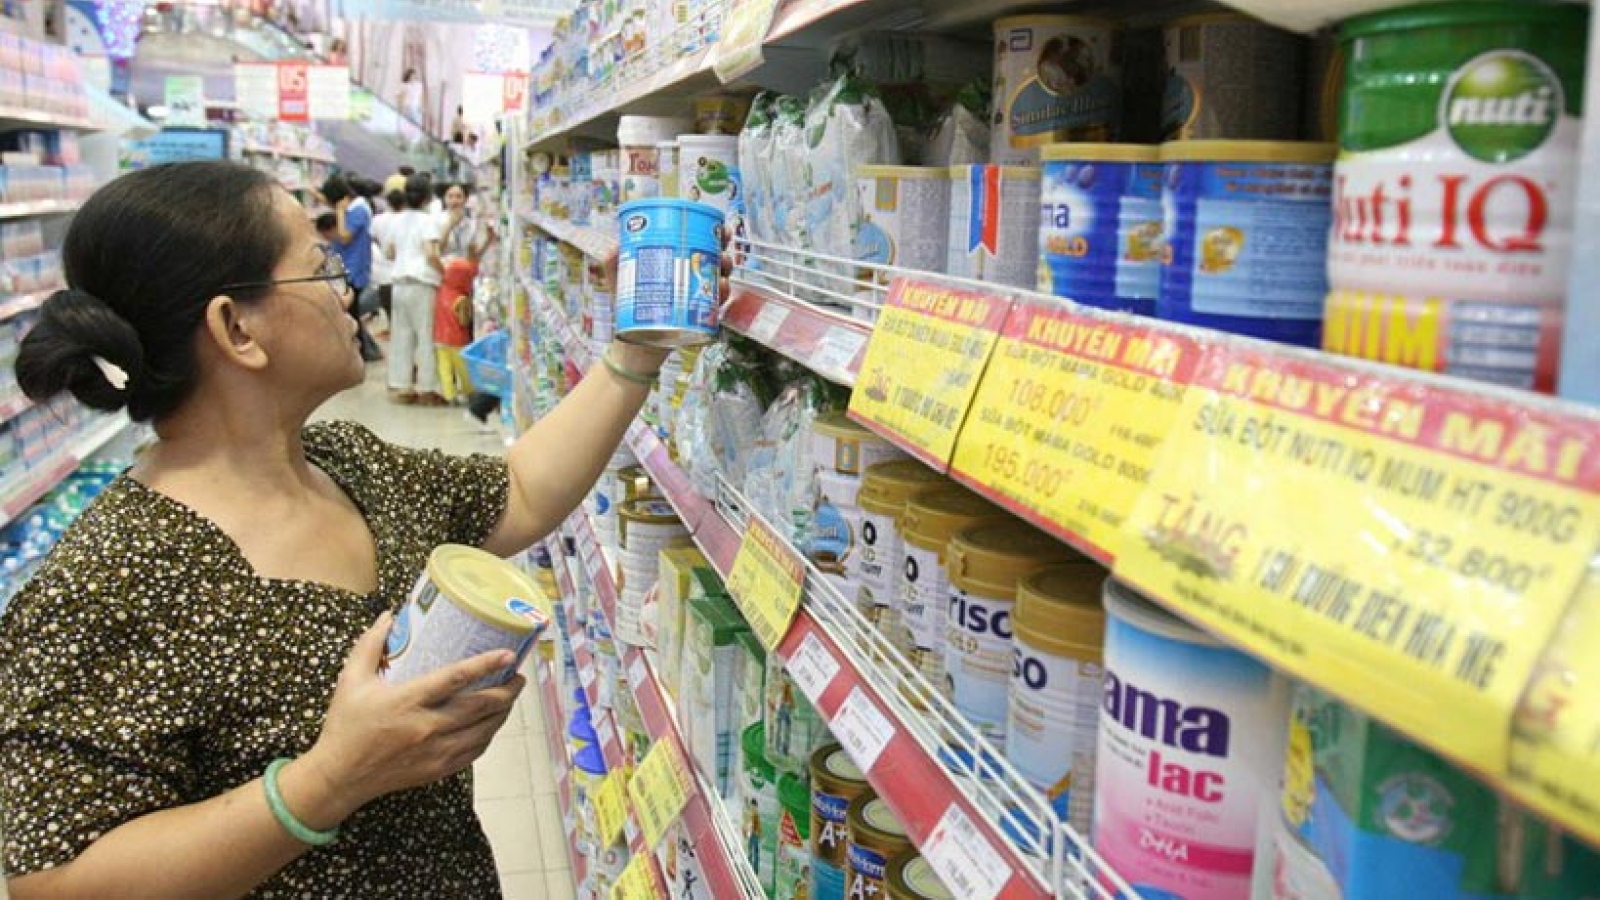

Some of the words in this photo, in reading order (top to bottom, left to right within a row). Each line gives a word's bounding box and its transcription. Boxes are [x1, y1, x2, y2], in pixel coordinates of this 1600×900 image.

[1450, 85, 1553, 126] nuti
[1433, 173, 1548, 254] IQ
[1446, 478, 1494, 516] HT
[1148, 750, 1225, 803] lac
